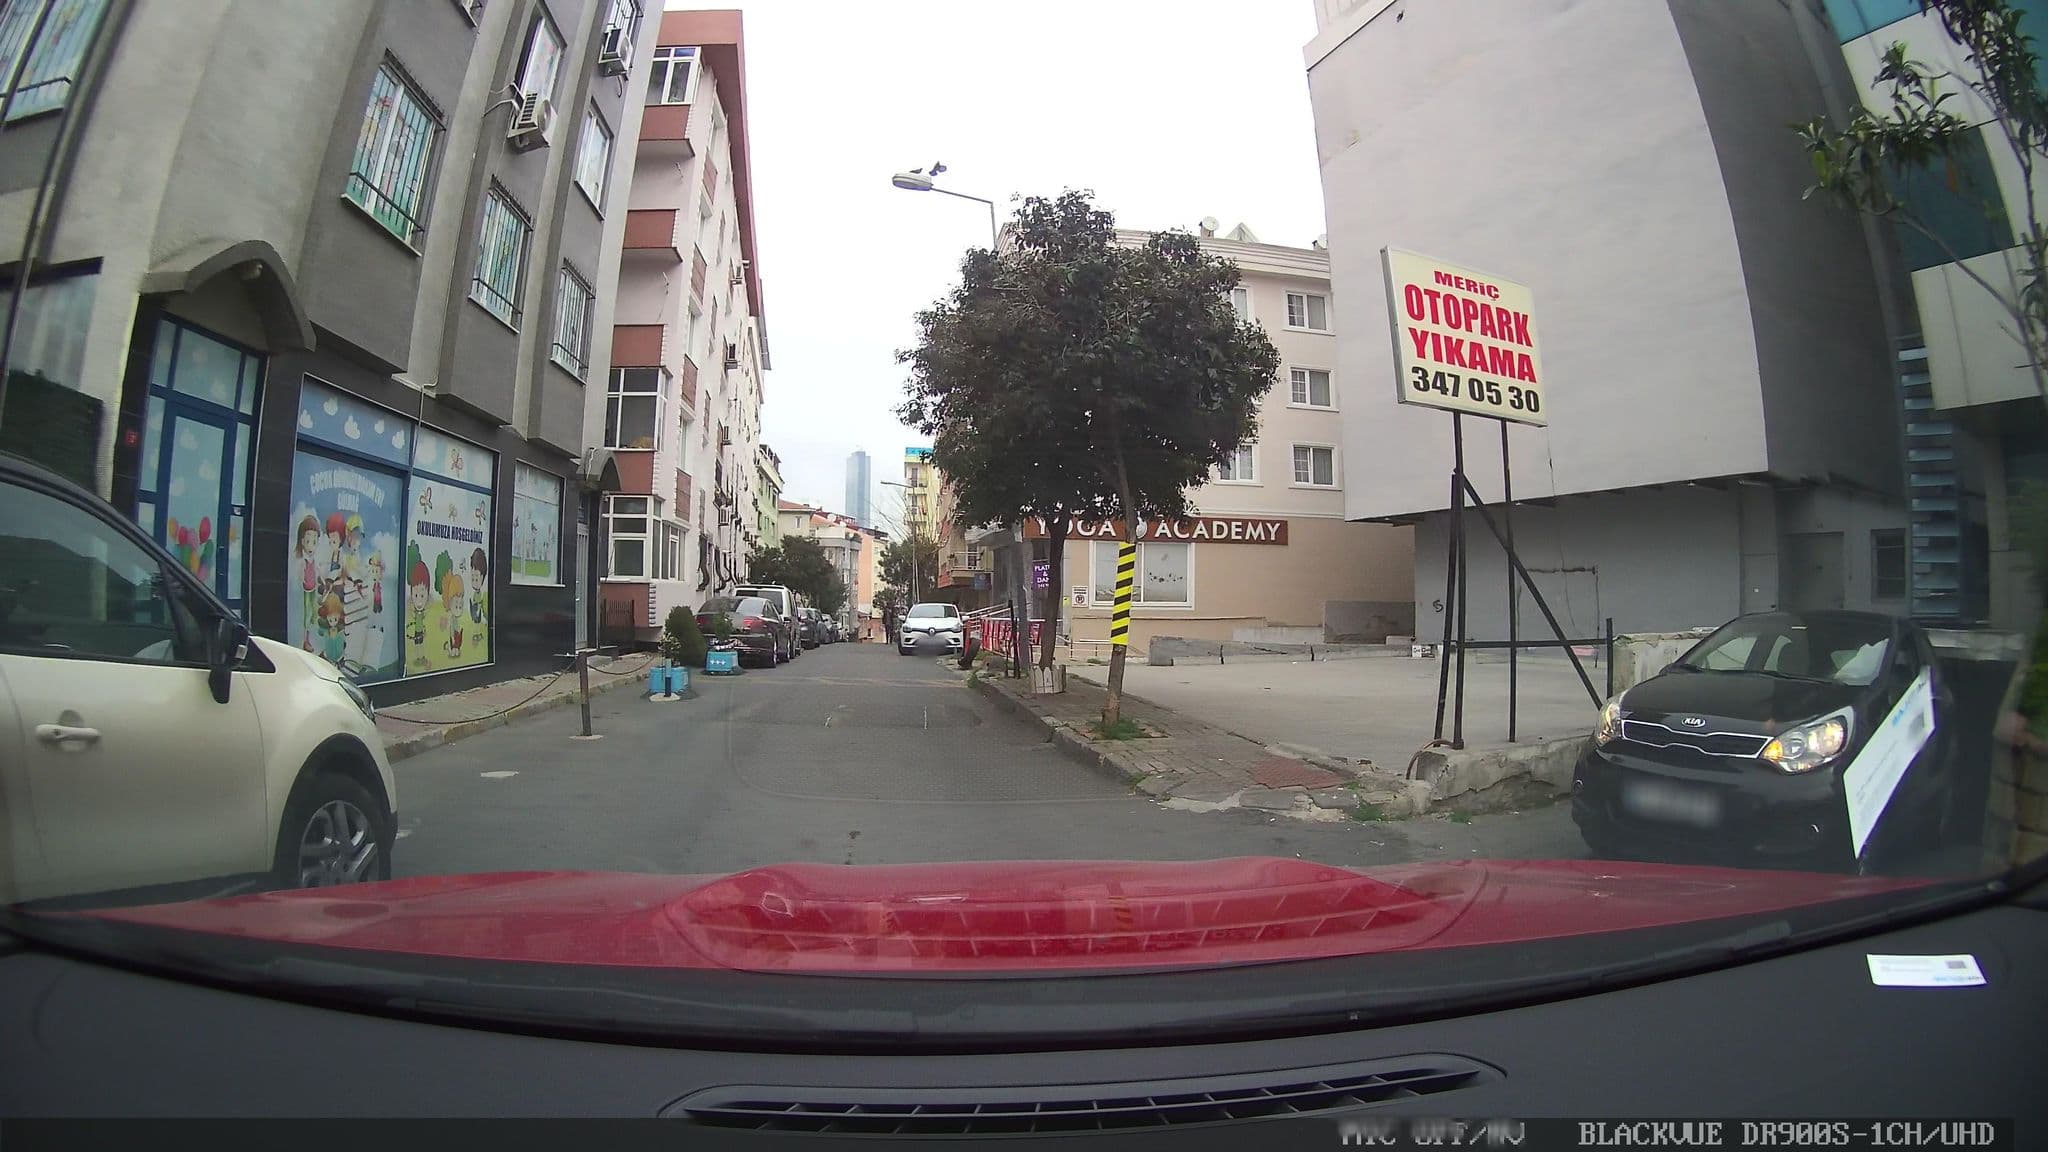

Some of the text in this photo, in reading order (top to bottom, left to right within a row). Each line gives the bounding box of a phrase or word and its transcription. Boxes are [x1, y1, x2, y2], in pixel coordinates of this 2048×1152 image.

[1404, 284, 1533, 347] OTOPARK
[1408, 327, 1537, 383] YIKAMA
[1411, 366, 1540, 413] 347 05 30
[1154, 519, 1281, 541] ACADEMY
[1684, 717, 1702, 725] KIA
